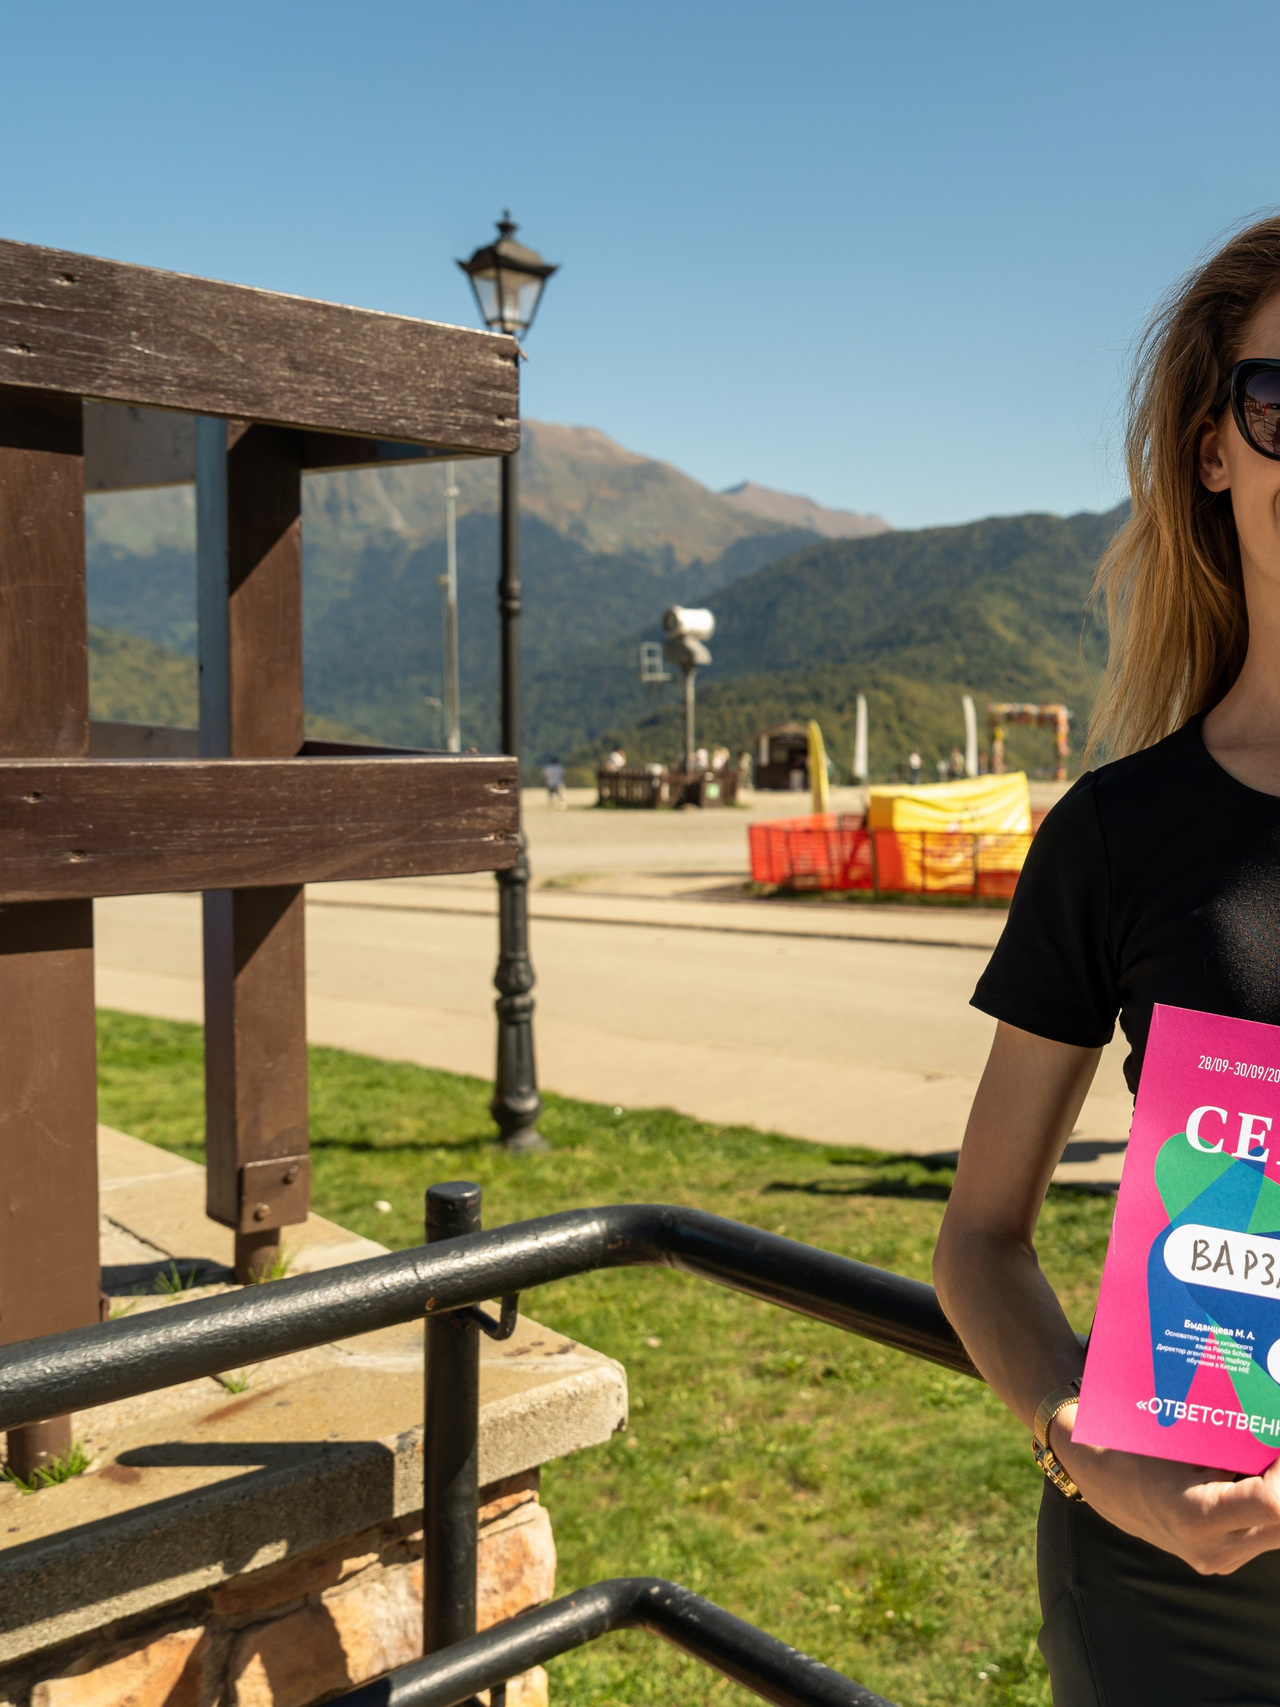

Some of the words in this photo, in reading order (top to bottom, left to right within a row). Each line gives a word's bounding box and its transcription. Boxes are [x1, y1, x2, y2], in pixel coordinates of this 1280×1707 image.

[1164, 1329, 1200, 1342] Основатель
[1183, 1319, 1234, 1336] Быданцева
[1235, 1328, 1245, 1338] М.
[1246, 1331, 1255, 1340] А.
[1156, 1343, 1187, 1355] Директор
